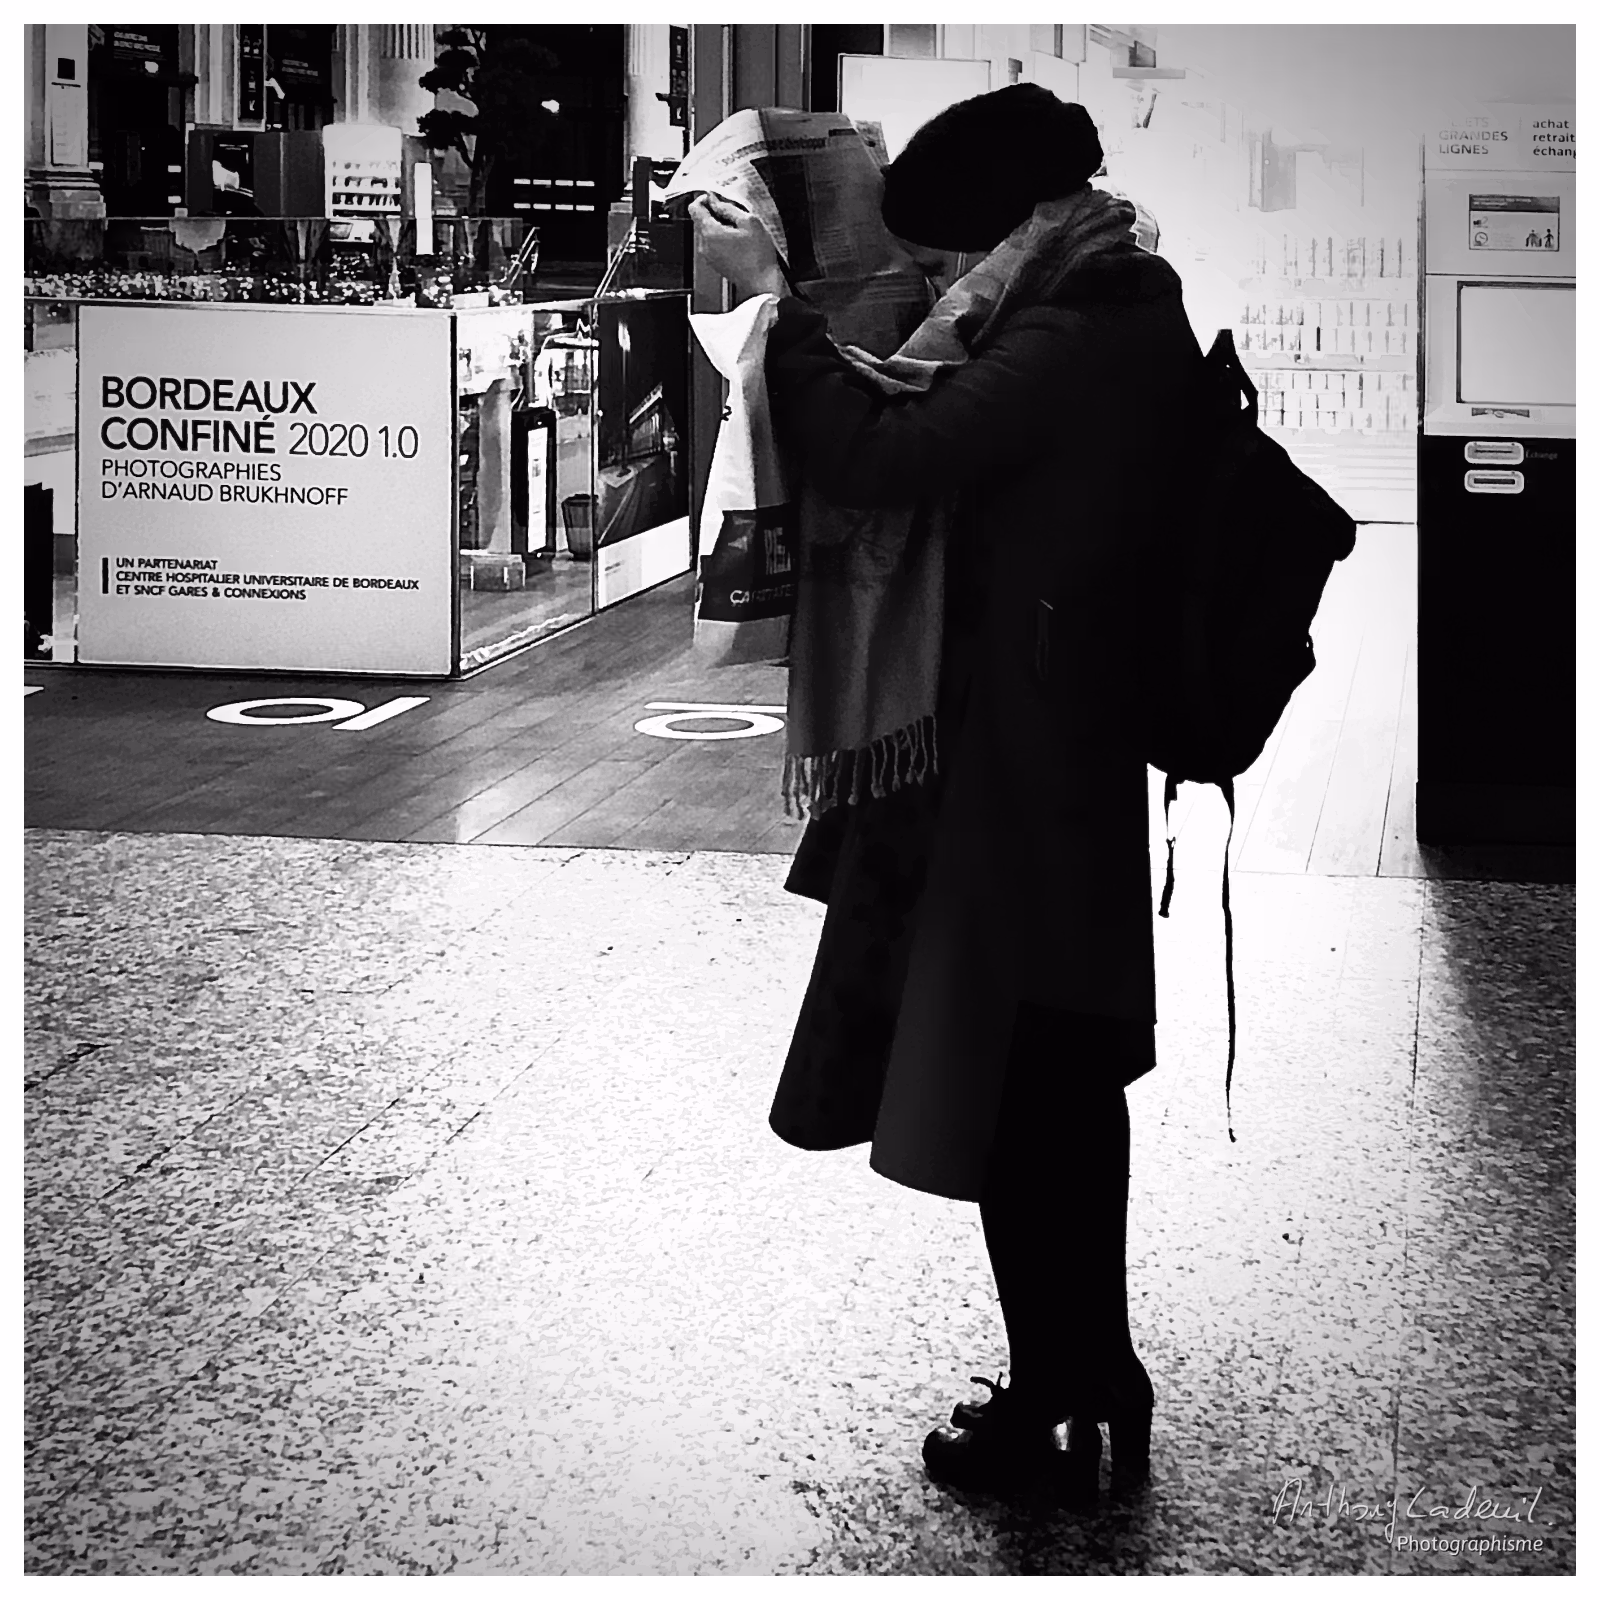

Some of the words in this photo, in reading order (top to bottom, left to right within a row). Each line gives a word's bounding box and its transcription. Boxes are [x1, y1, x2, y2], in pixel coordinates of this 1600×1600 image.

[1532, 118, 1569, 129] achat
[1438, 130, 1508, 141] GRANDES
[1532, 131, 1576, 142] retrait
[1438, 144, 1489, 155] LIGNES
[102, 375, 317, 414] BORDEAUX
[101, 414, 275, 453] CONFINÉ
[288, 422, 369, 457] 2020
[377, 424, 418, 458] 1.0
[102, 459, 282, 481] PHOTOGRAPHIES
[219, 485, 348, 505] BRUKHNOFF
[115, 557, 134, 568] UN
[137, 558, 218, 570] PARTENARIAT
[115, 570, 162, 582] CENTRE
[166, 572, 240, 584] HOSPITALIER
[243, 574, 329, 587] UNIVERSITAIRE
[333, 577, 349, 588] DE
[352, 578, 420, 590] BORDEAUX
[115, 583, 131, 595] ET
[134, 585, 165, 597] SNCF
[168, 586, 207, 598] GARES
[211, 587, 221, 598] &
[224, 587, 307, 600] CONNEXIONS
